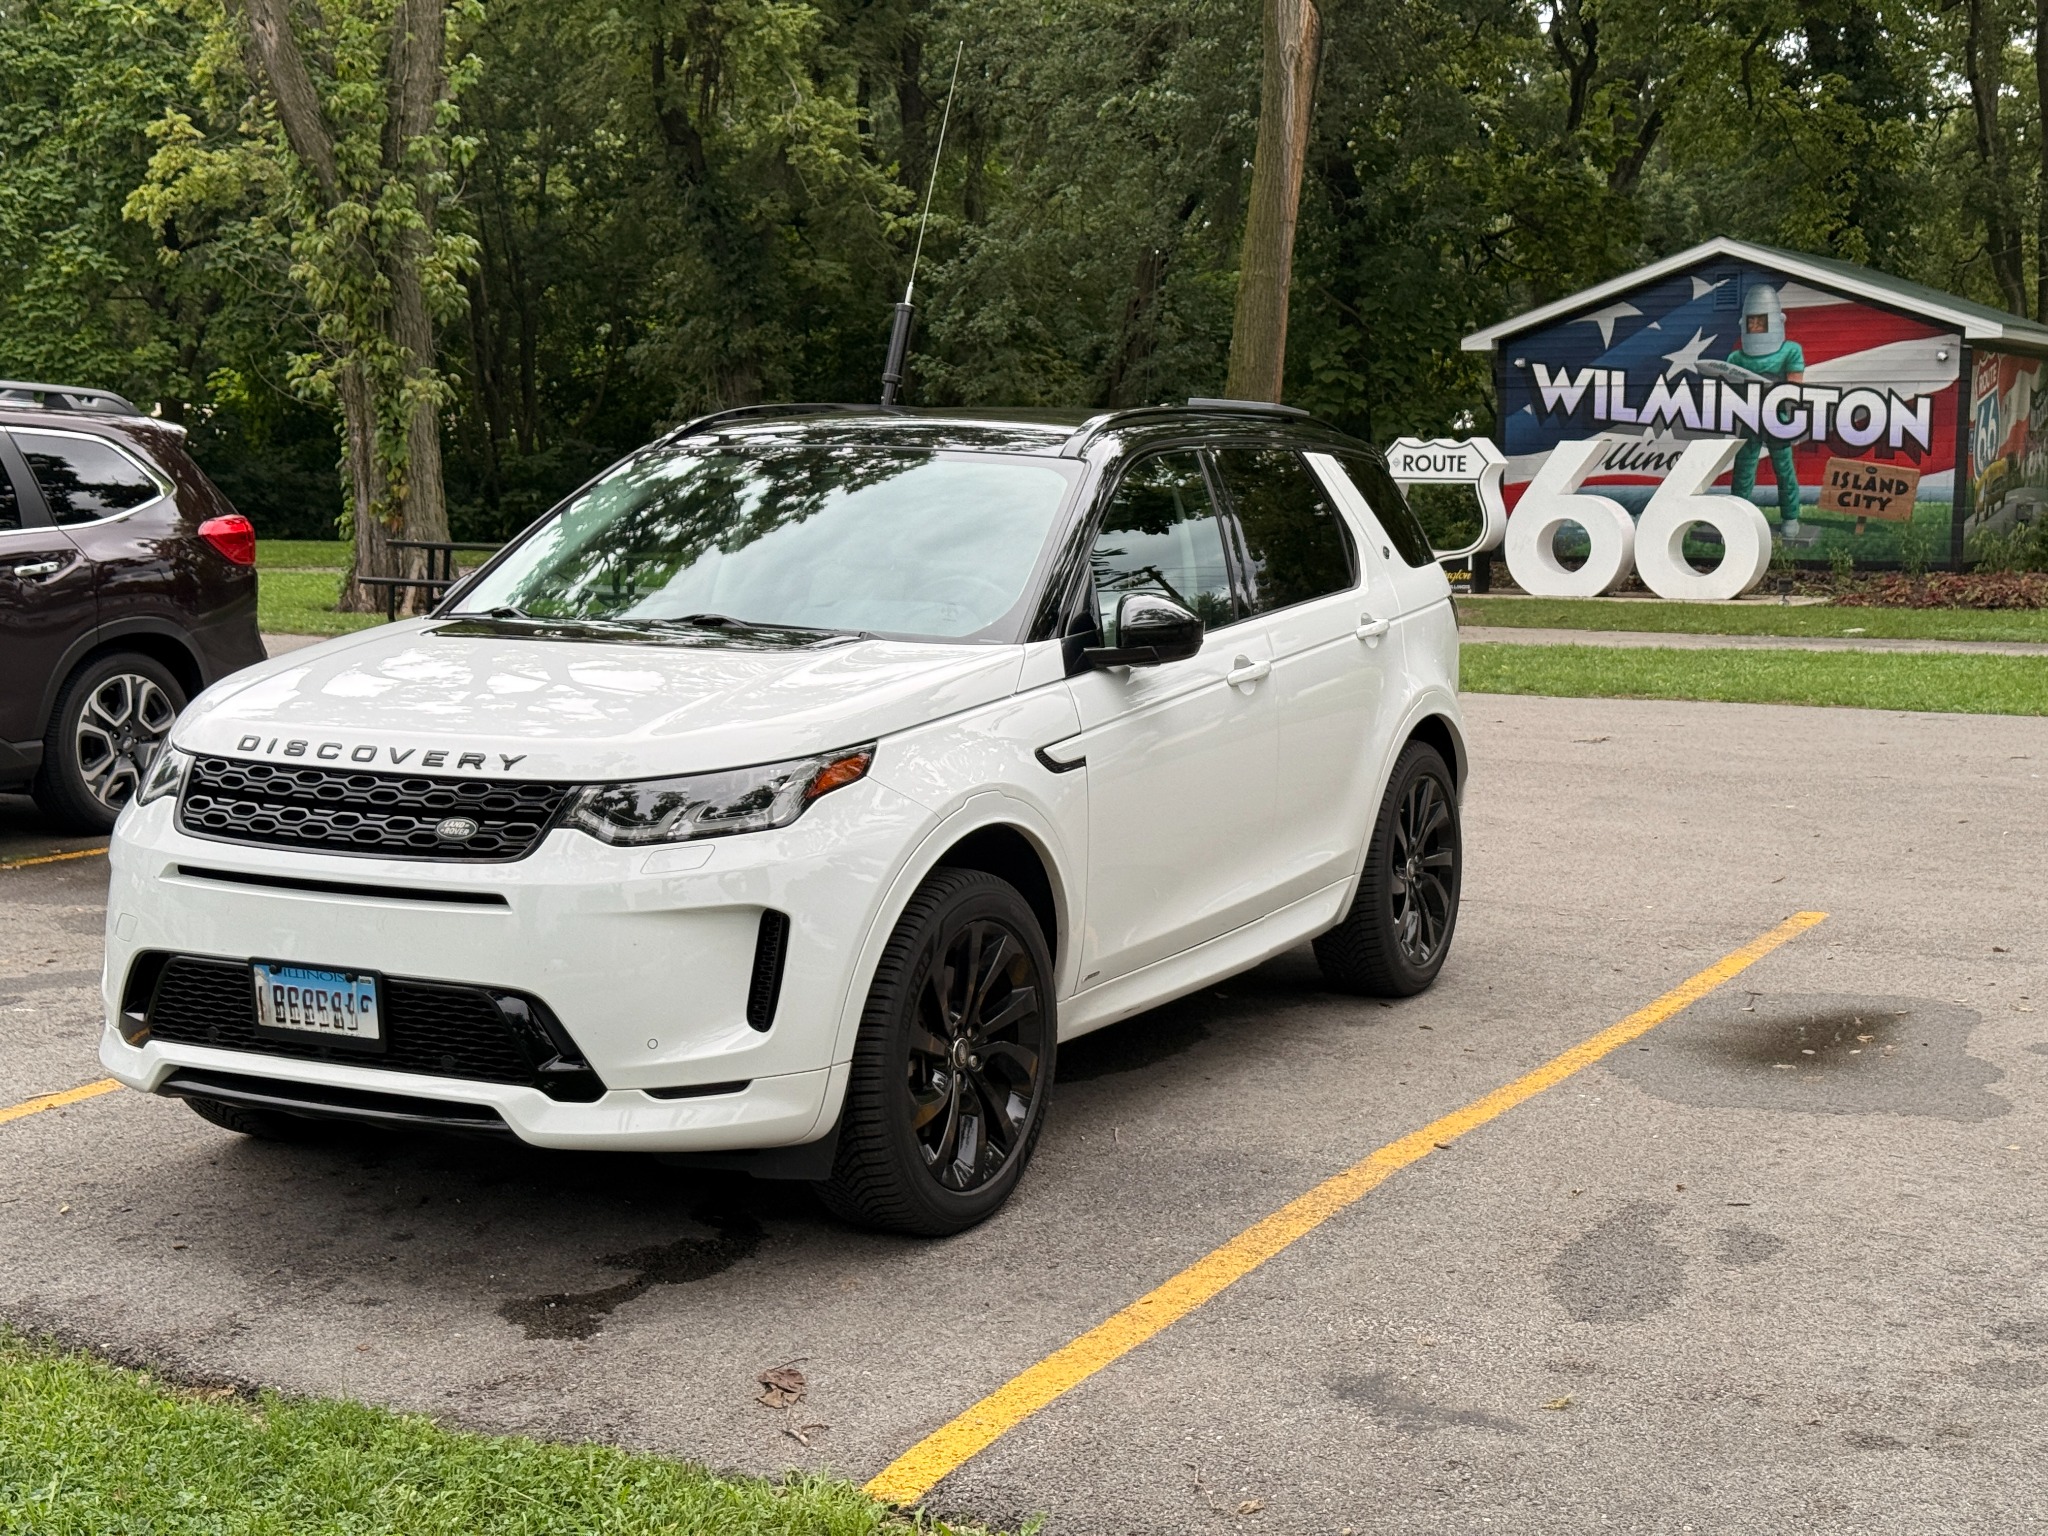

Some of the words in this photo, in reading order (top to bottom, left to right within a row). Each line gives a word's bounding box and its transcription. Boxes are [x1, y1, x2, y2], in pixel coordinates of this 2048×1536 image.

[1978, 362, 1998, 396] ROUTE
[1530, 361, 1932, 453] WILMINGTON
[1976, 397, 1998, 473] 66
[1402, 454, 1467, 473] ROUTE
[1831, 470, 1909, 496] ISLAND
[1837, 491, 1893, 512] CITY
[1504, 438, 1772, 600] 66
[236, 734, 528, 771] DISCOVERY
[444, 827, 470, 836] ROVER
[282, 966, 347, 983] ILLINOIS
